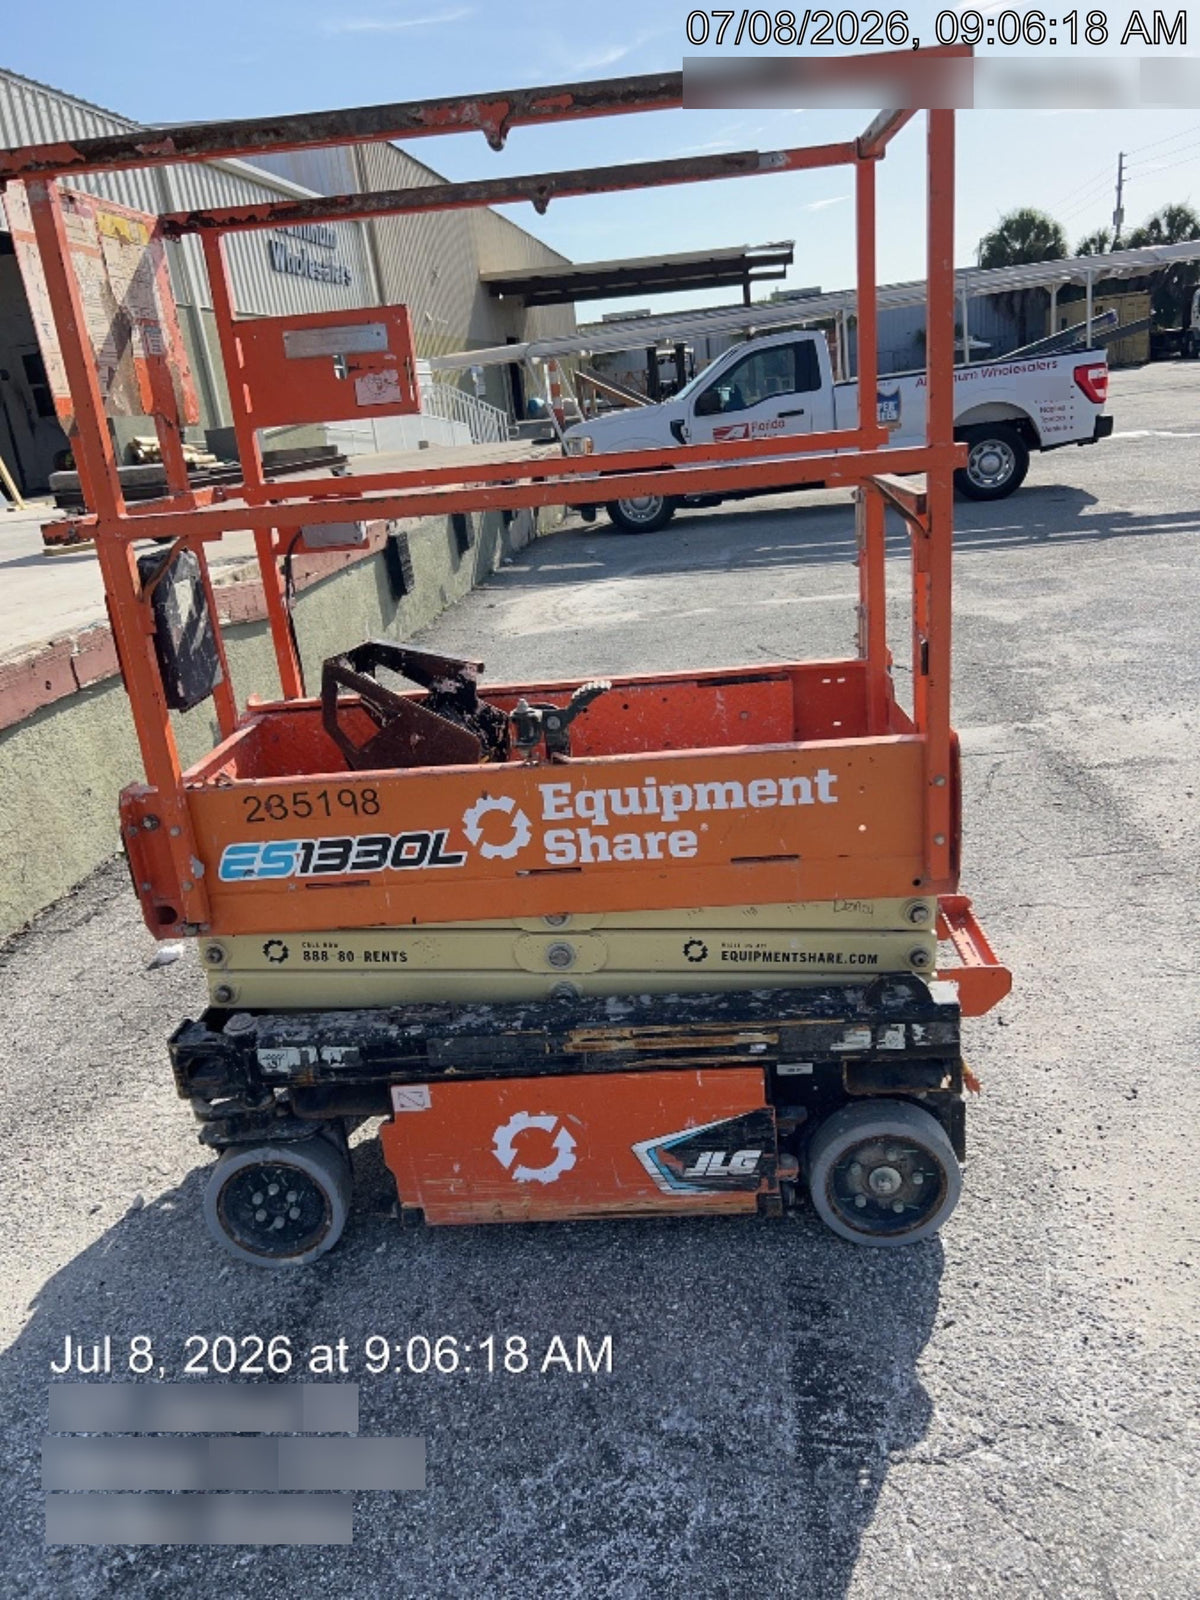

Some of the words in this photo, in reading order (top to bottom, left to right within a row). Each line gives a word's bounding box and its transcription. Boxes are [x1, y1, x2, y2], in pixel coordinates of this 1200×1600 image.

[538, 769, 838, 826] Equipment
[218, 829, 468, 882] ES1330L
[543, 827, 698, 864] Share
[721, 950, 878, 964] EQUIPMENTSHARE.COM
[683, 1149, 762, 1176] JLG
